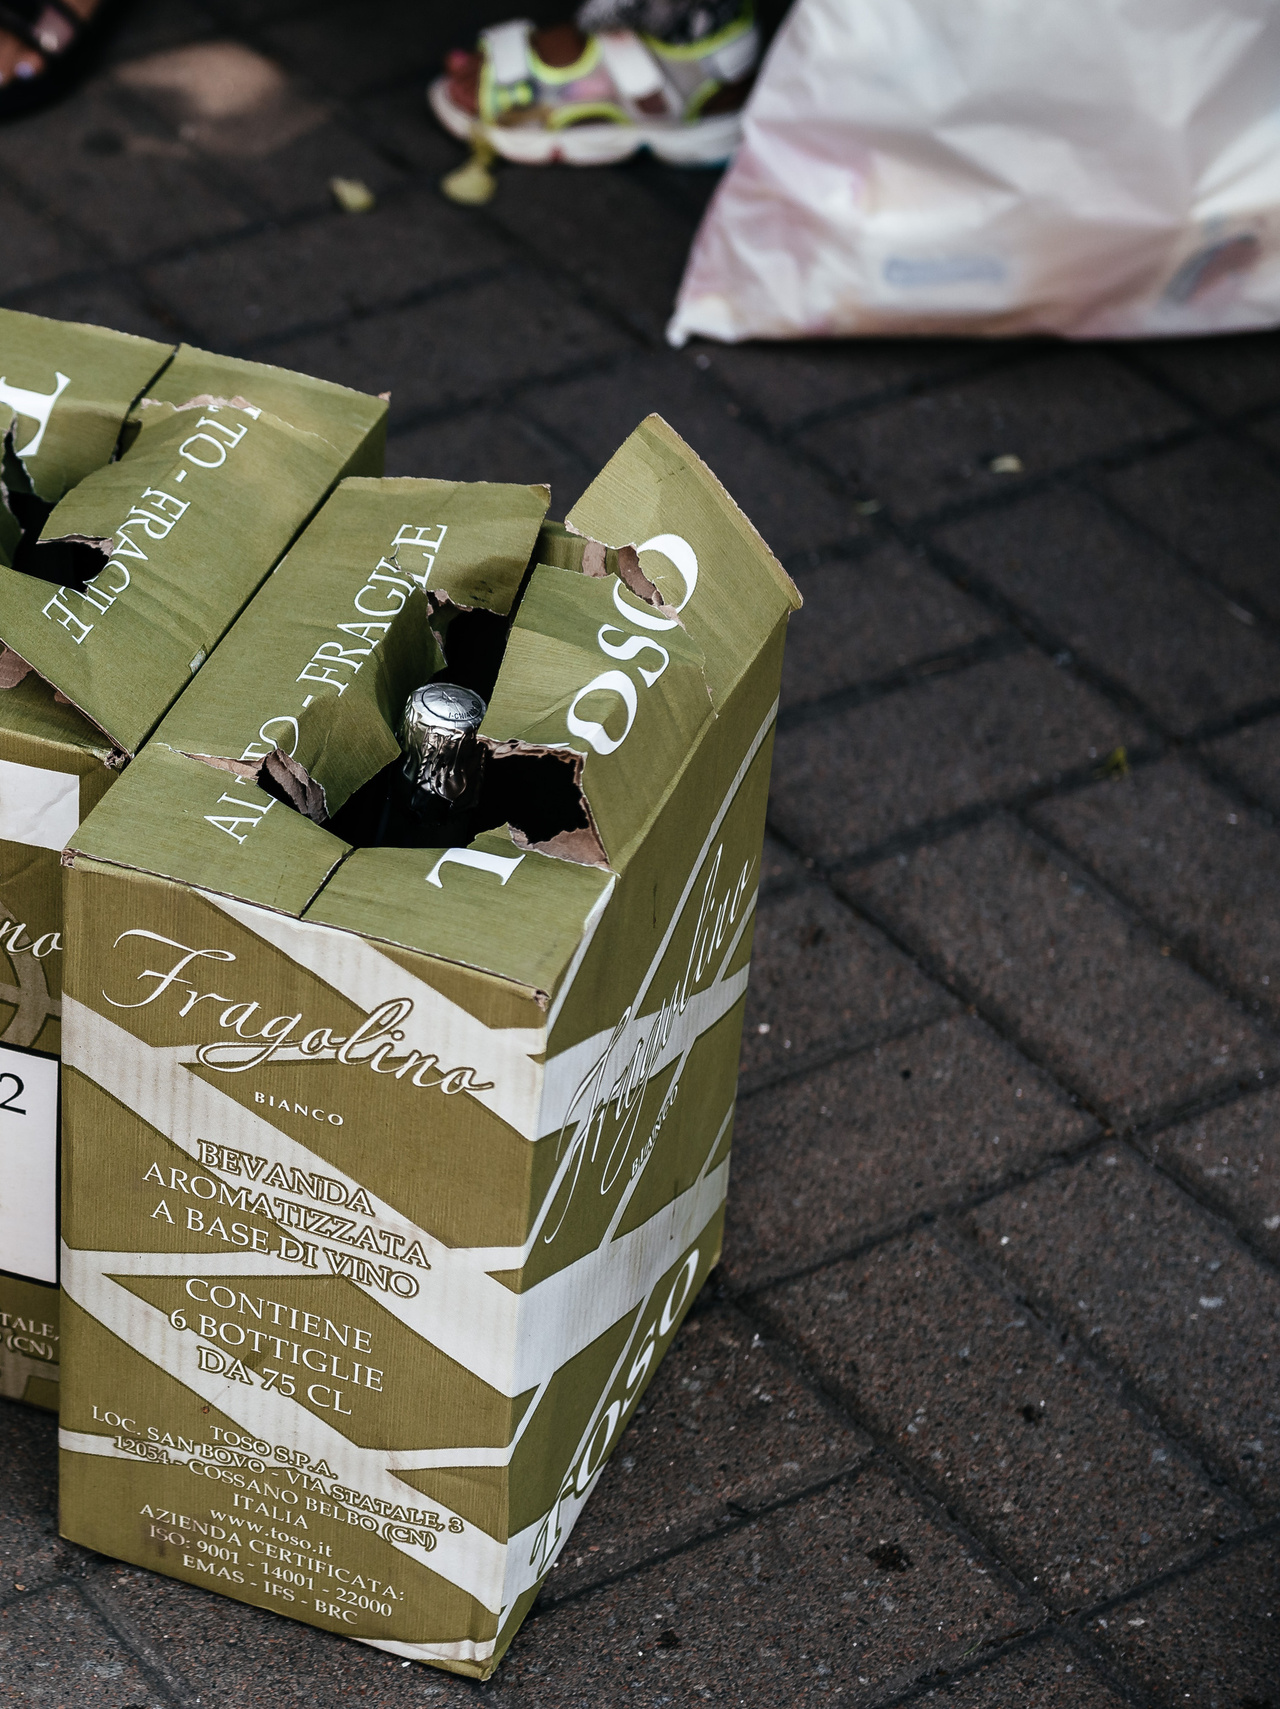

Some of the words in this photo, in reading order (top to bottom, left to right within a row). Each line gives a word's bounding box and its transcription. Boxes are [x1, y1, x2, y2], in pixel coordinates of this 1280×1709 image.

[296, 523, 448, 696] FRAGILE
[102, 929, 493, 1095] Fragolino
[544, 843, 757, 1245] Fragolino
[254, 1091, 345, 1127] BIANCO
[142, 1161, 431, 1269] AROMATIZZATA
[198, 1139, 375, 1217] BEVANDA
[150, 1199, 175, 1224] A
[186, 1207, 270, 1254] BASE
[278, 1235, 318, 1269] DI
[323, 1249, 420, 1299] VINO
[6, 1335, 53, 1360] (CN)
[170, 1307, 187, 1330] 6
[199, 1314, 384, 1392] BOTTIGLIE
[185, 1277, 372, 1354] CONTIENE
[197, 1346, 254, 1386] DA
[262, 1367, 297, 1397] 75
[307, 1384, 352, 1416] CL
[529, 1248, 700, 1581] TOSO
[92, 1405, 141, 1436] LOC.
[147, 1426, 194, 1454] SAN
[200, 1443, 266, 1474] BOVO
[285, 1469, 327, 1496] VIA
[330, 1483, 446, 1532] STATALE,
[448, 1516, 465, 1534] 3
[114, 1435, 169, 1465] 12054
[188, 1459, 298, 1505] COSSANO
[306, 1496, 379, 1533] BELBO
[382, 1522, 437, 1552] (CN)
[210, 1425, 271, 1456] TOSO
[274, 1445, 339, 1481] S.P.A.
[139, 1504, 243, 1547] AZIENDA
[248, 1539, 405, 1601] CERTIFICATA:
[210, 1508, 332, 1558] www.toso.it
[233, 1493, 309, 1530] ITALIA
[150, 1524, 192, 1549] ISO:
[196, 1540, 240, 1565] 9001
[261, 1562, 314, 1591] 14001
[336, 1588, 393, 1618] 22000
[182, 1554, 244, 1584] EMAS
[264, 1580, 295, 1603] IFS
[315, 1599, 358, 1625] BRC
